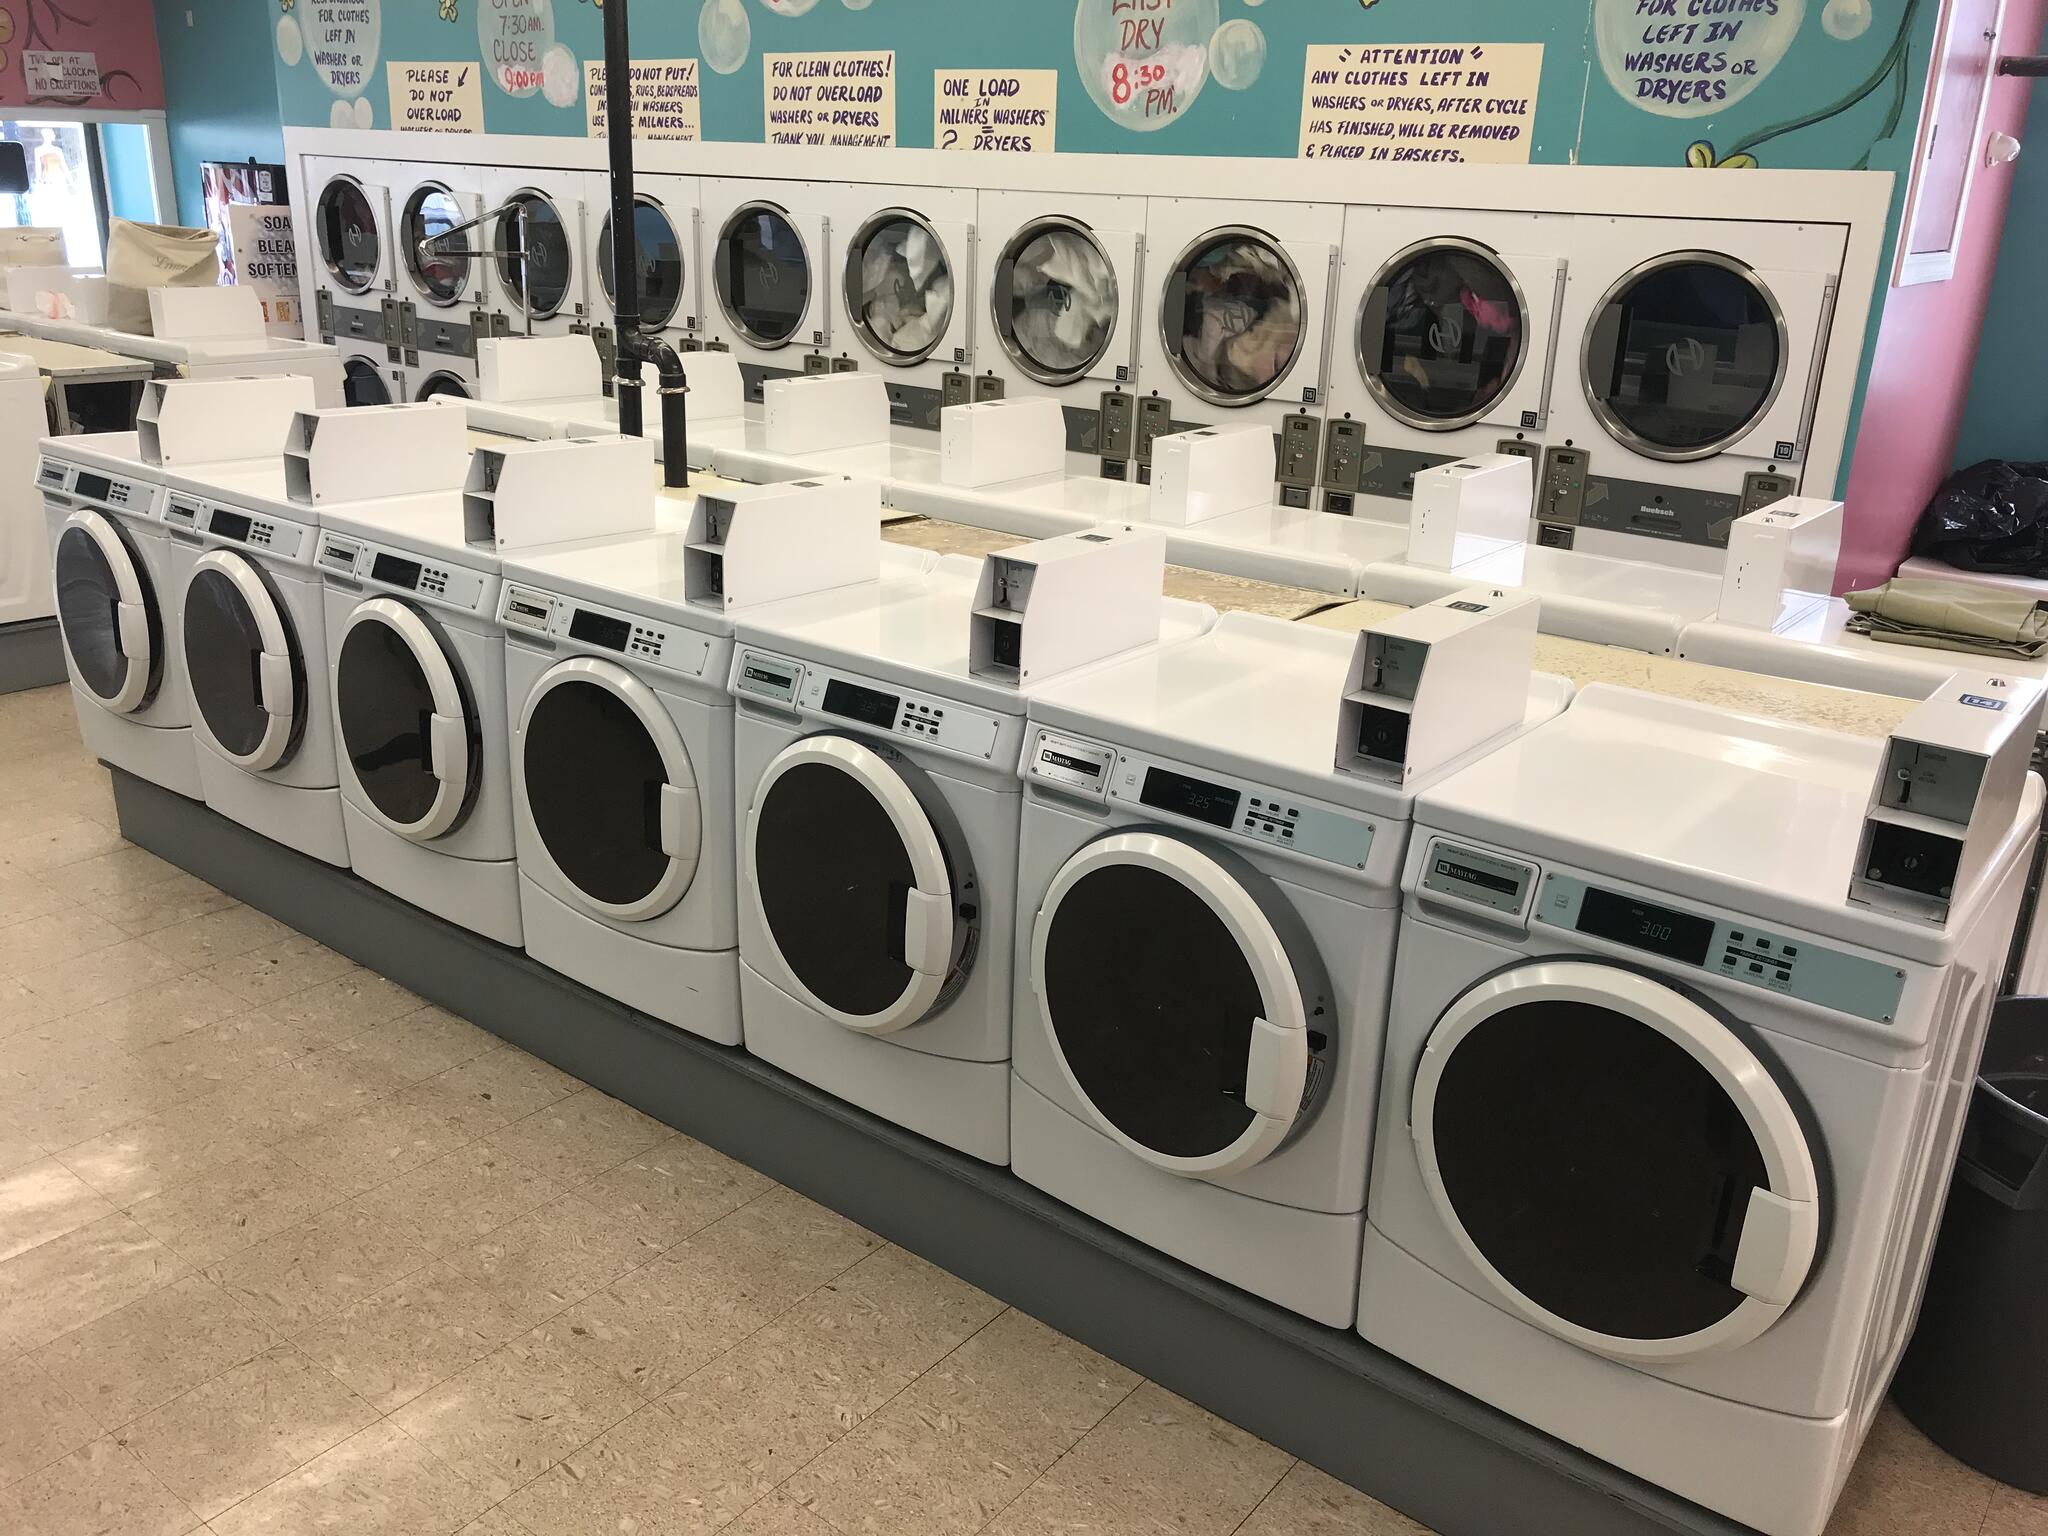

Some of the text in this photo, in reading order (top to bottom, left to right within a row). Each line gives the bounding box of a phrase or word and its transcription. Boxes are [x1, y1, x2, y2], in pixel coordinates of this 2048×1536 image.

[319, 9, 369, 24] FOR CLOTHES
[499, 15, 526, 35] 7:30
[325, 29, 355, 44] LEFT IN
[1120, 17, 1164, 51] DRY
[1642, 20, 1743, 45] LEFT IN
[314, 51, 363, 66] WASHERS OR
[493, 39, 536, 63] CLOSE
[629, 69, 641, 80] DO
[643, 68, 661, 80] NOT
[665, 63, 694, 81] PUT!
[772, 54, 892, 78] FOR CLEAN CLOTHES!
[1625, 51, 1758, 76] WASHERS OR
[35, 78, 97, 91] NO EXCEPTIONS
[330, 71, 361, 86] DRYERS
[406, 70, 449, 83] PLEASE
[505, 68, 544, 92] 9:00 PM
[1112, 63, 1165, 104] 8:30
[1311, 70, 1489, 86] ANY CLOTHES LEFT IN
[409, 90, 453, 102] DO NOT
[773, 86, 883, 103] DO NOT OVERLOAD
[943, 79, 1020, 97] ONE LOAD
[1635, 78, 1727, 104] DRYERS
[642, 101, 683, 114] WASHERS
[973, 98, 990, 108] IN
[1312, 96, 1528, 115] WASHERS OR DRYERS, AFTER CYCLE
[407, 108, 462, 122] OVERLOAD
[592, 115, 605, 127] USE
[770, 110, 879, 127] WASHERS OR DRYERS
[940, 109, 1046, 126] MILNERS WASHERS
[771, 132, 804, 144] THANK
[1309, 120, 1520, 141] HAS FINISHED, WILL BE REMOVED
[973, 135, 1031, 152] DRYERS
[1306, 144, 1465, 163] & PLACED IN BASKETS.
[264, 215, 292, 231] SOA
[258, 239, 295, 254] BLEA
[1450, 867, 1477, 881] MAYTAG
